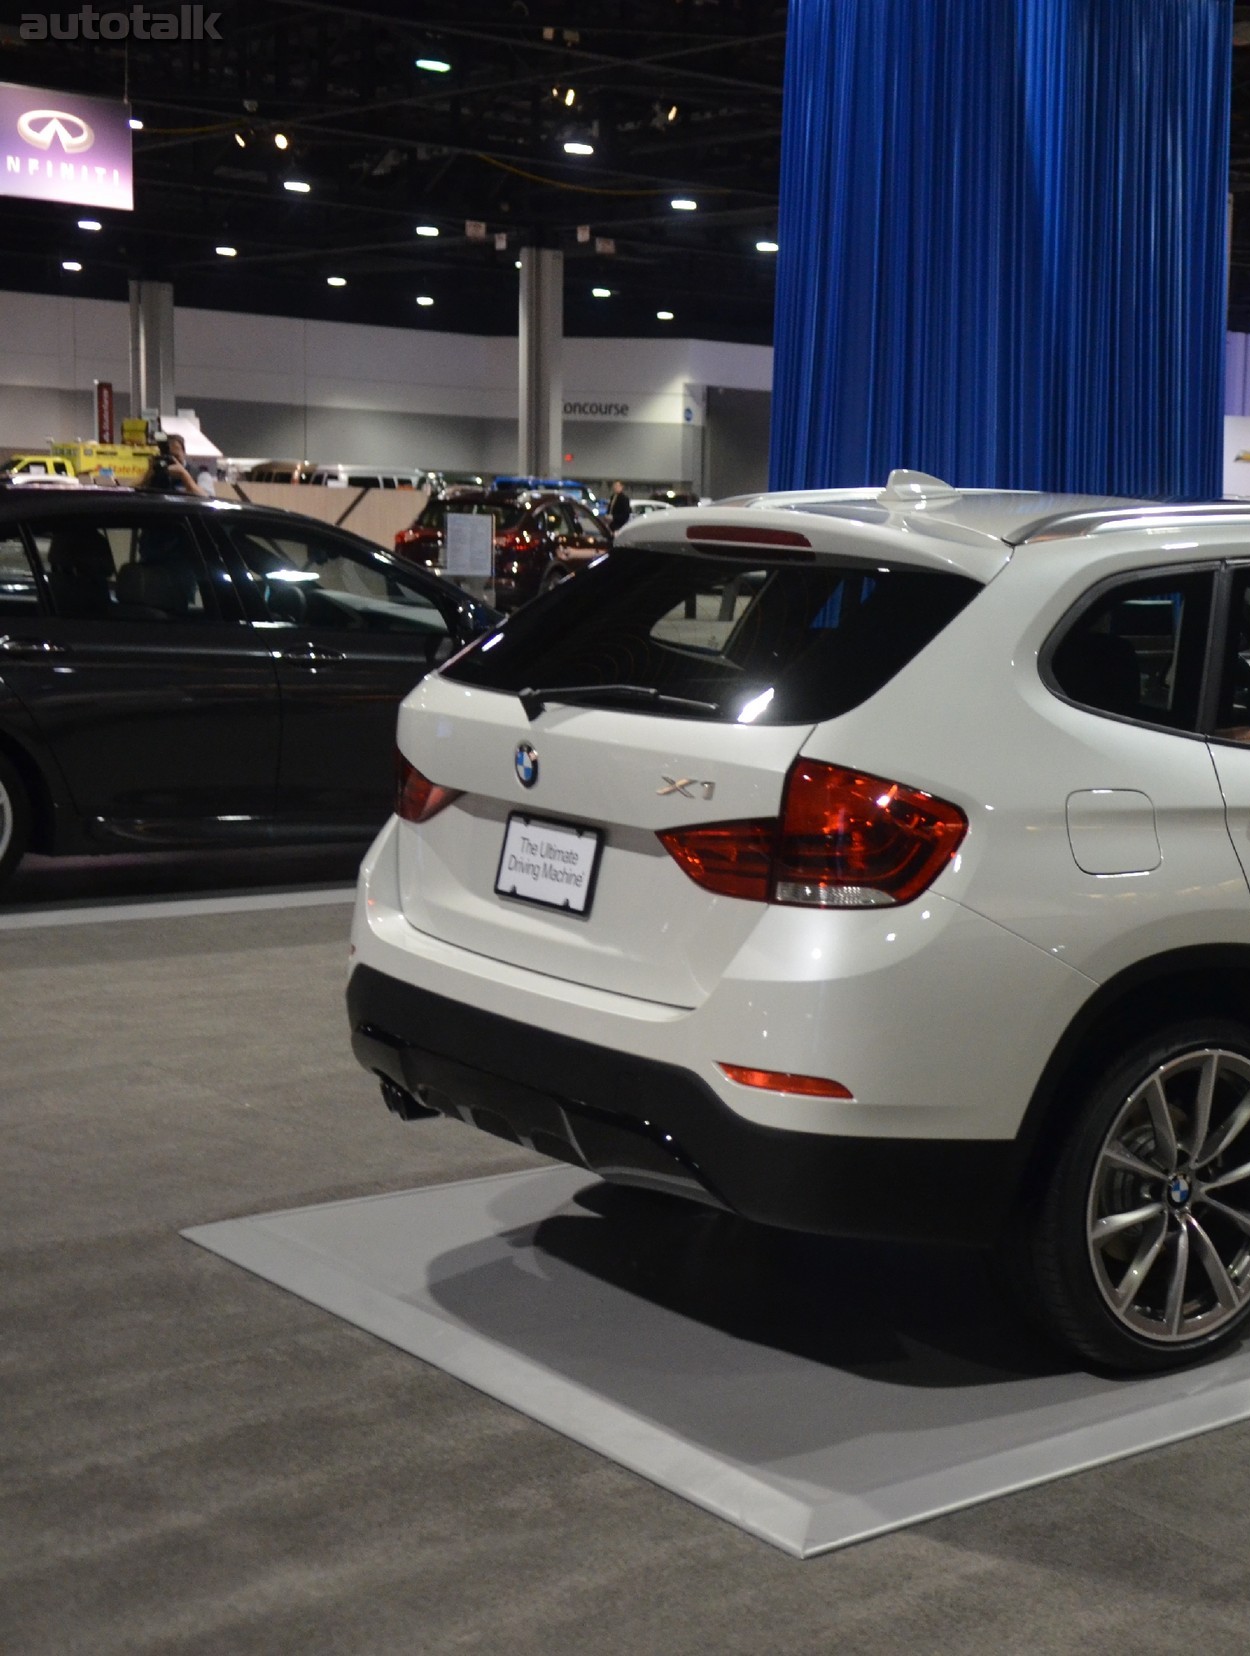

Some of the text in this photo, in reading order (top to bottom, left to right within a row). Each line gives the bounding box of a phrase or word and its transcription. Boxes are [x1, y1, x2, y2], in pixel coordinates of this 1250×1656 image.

[6, 155, 119, 185] NFINITI
[562, 402, 629, 416] oncourse
[656, 776, 715, 800] X1
[521, 836, 579, 865] The Ultimate
[508, 854, 540, 881] Driving
